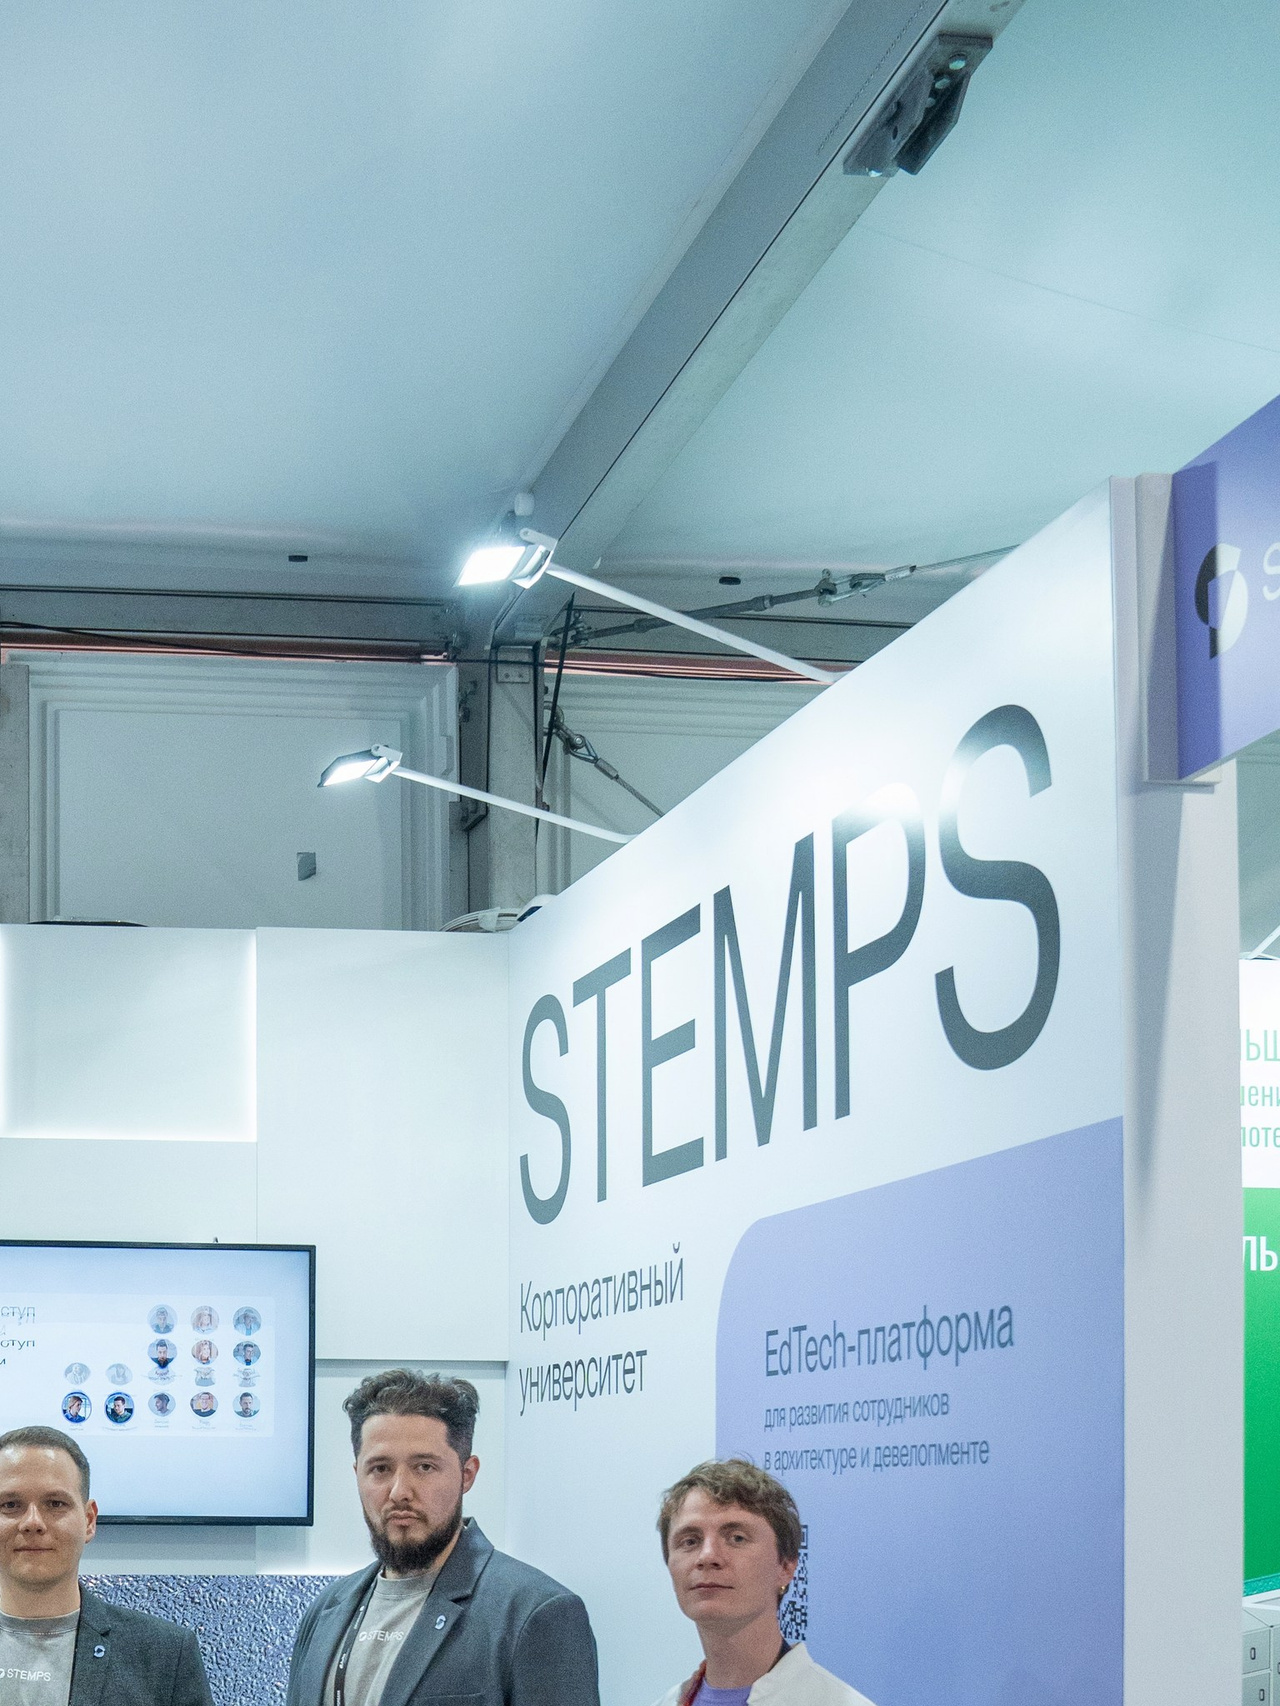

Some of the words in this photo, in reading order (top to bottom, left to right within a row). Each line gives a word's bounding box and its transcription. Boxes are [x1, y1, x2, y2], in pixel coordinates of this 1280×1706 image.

[520, 704, 1061, 1224] STEMPS
[520, 1242, 684, 1340] Корпоративный
[765, 1304, 1014, 1377] EdTech-платформа
[520, 1349, 648, 1416] университет
[764, 1406, 787, 1432] для
[789, 1401, 849, 1432] развития
[853, 1392, 950, 1427] сотрудников
[764, 1450, 771, 1470] в
[774, 1446, 857, 1477] архитектуре
[861, 1447, 870, 1468] и
[873, 1439, 990, 1475] девелопменте
[367, 1630, 404, 1641] STEMPS
[7, 1668, 51, 1681] STEMPS
